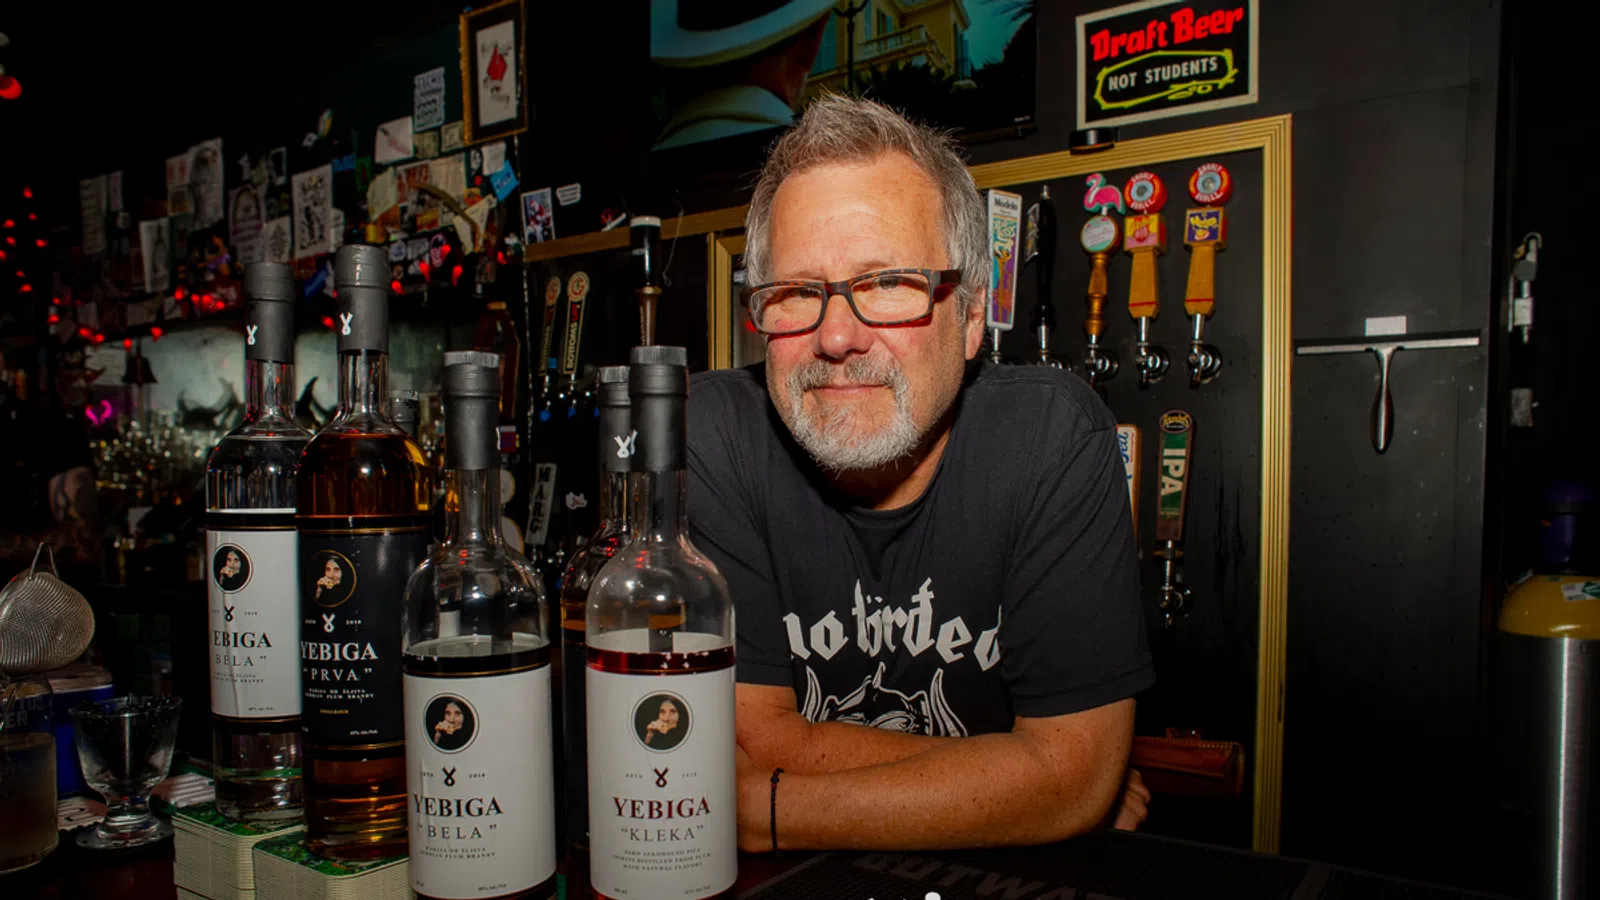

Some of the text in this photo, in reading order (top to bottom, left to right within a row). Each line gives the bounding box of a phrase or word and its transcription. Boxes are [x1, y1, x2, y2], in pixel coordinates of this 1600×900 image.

[1091, 8, 1244, 61] Draft Beer
[1108, 57, 1218, 91] NOT STUDENTS
[995, 197, 1018, 211] Modelo
[1160, 447, 1187, 496] IPA
[212, 630, 273, 649] EBIGA
[300, 641, 379, 661] YEBIGA
[413, 793, 505, 818] YEBIGA
[613, 795, 711, 820] YEBIGA
